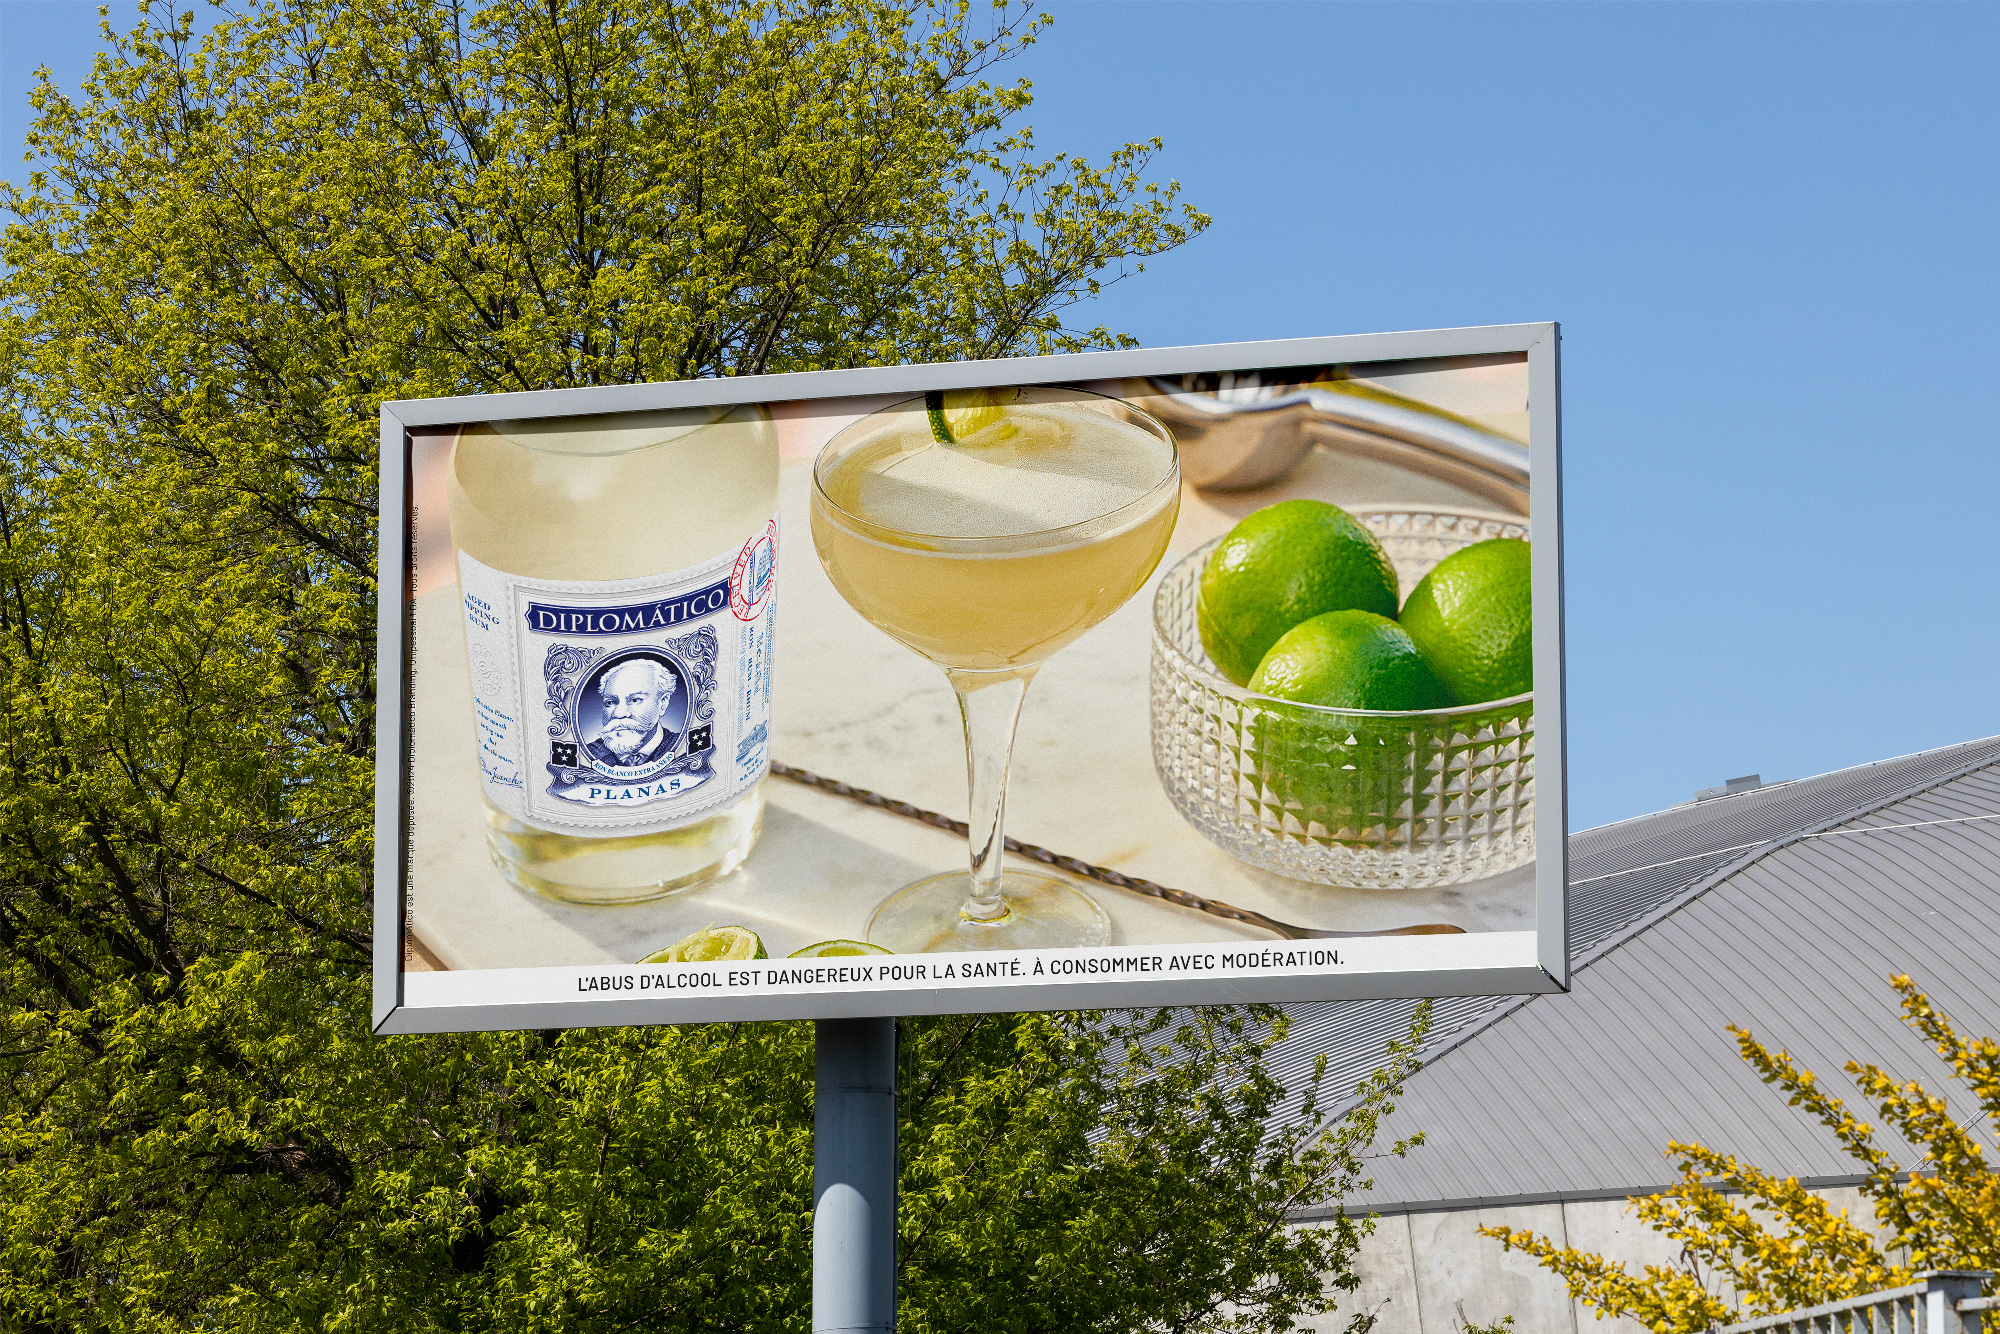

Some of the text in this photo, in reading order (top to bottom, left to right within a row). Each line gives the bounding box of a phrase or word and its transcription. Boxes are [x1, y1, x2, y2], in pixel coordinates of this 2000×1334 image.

[466, 591, 491, 611] AGED
[537, 589, 724, 632] DIPLOMÁTICO
[469, 613, 490, 632] RUM
[593, 753, 674, 777] RON BLANCO EXTRA AÑEJO
[588, 778, 681, 800] PLANAS
[578, 947, 1344, 992] L'ABUS D'ALCOOL EST DANGEREUX POUR LA SANTÉ. À CONSOMMER AVEC MODÉRATION.
